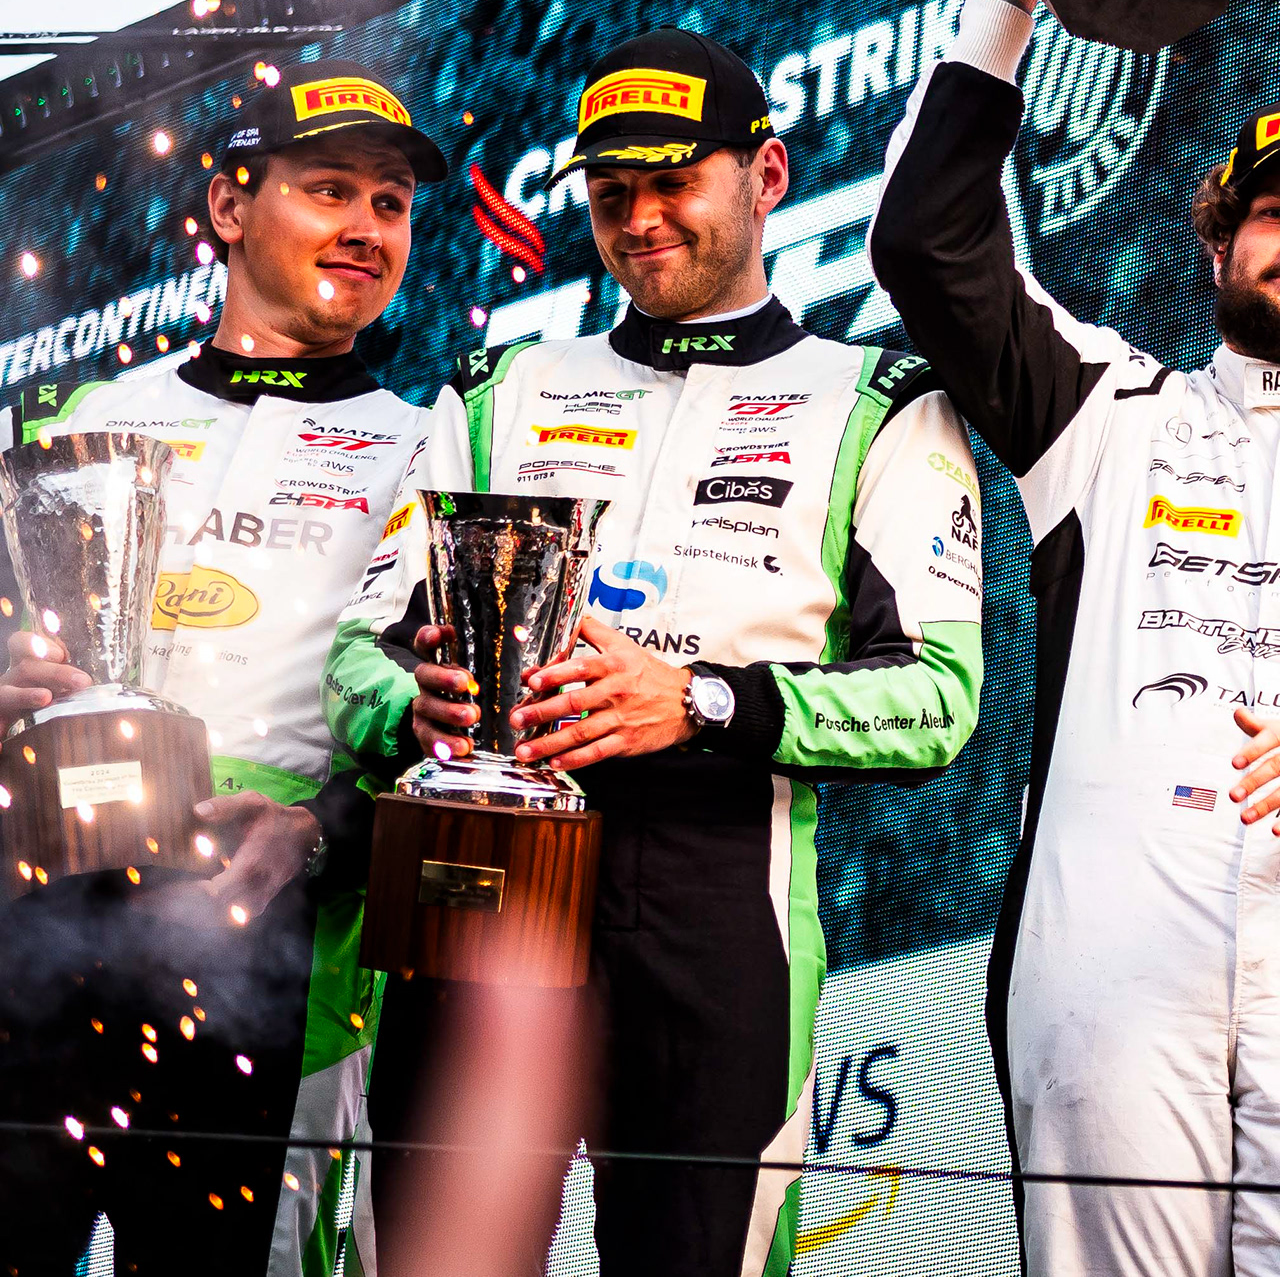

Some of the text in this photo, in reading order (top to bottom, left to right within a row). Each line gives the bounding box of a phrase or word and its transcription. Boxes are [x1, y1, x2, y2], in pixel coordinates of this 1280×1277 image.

[584, 77, 691, 122] PIRELLI
[661, 335, 736, 354] HRX
[230, 370, 308, 389] HRX
[729, 393, 812, 402] FANATEC
[562, 407, 621, 416] RACING
[564, 401, 623, 409] HUBER
[538, 424, 629, 446] PIRELLI
[749, 426, 777, 434] aws
[719, 440, 790, 453] CROWDSTRIKE
[329, 449, 379, 462] CHALLENGE
[320, 459, 355, 473] aws
[518, 460, 617, 472] PORSCHE
[1151, 500, 1234, 531] PIRELLI
[950, 525, 979, 551] NAF
[873, 714, 917, 732] Center
